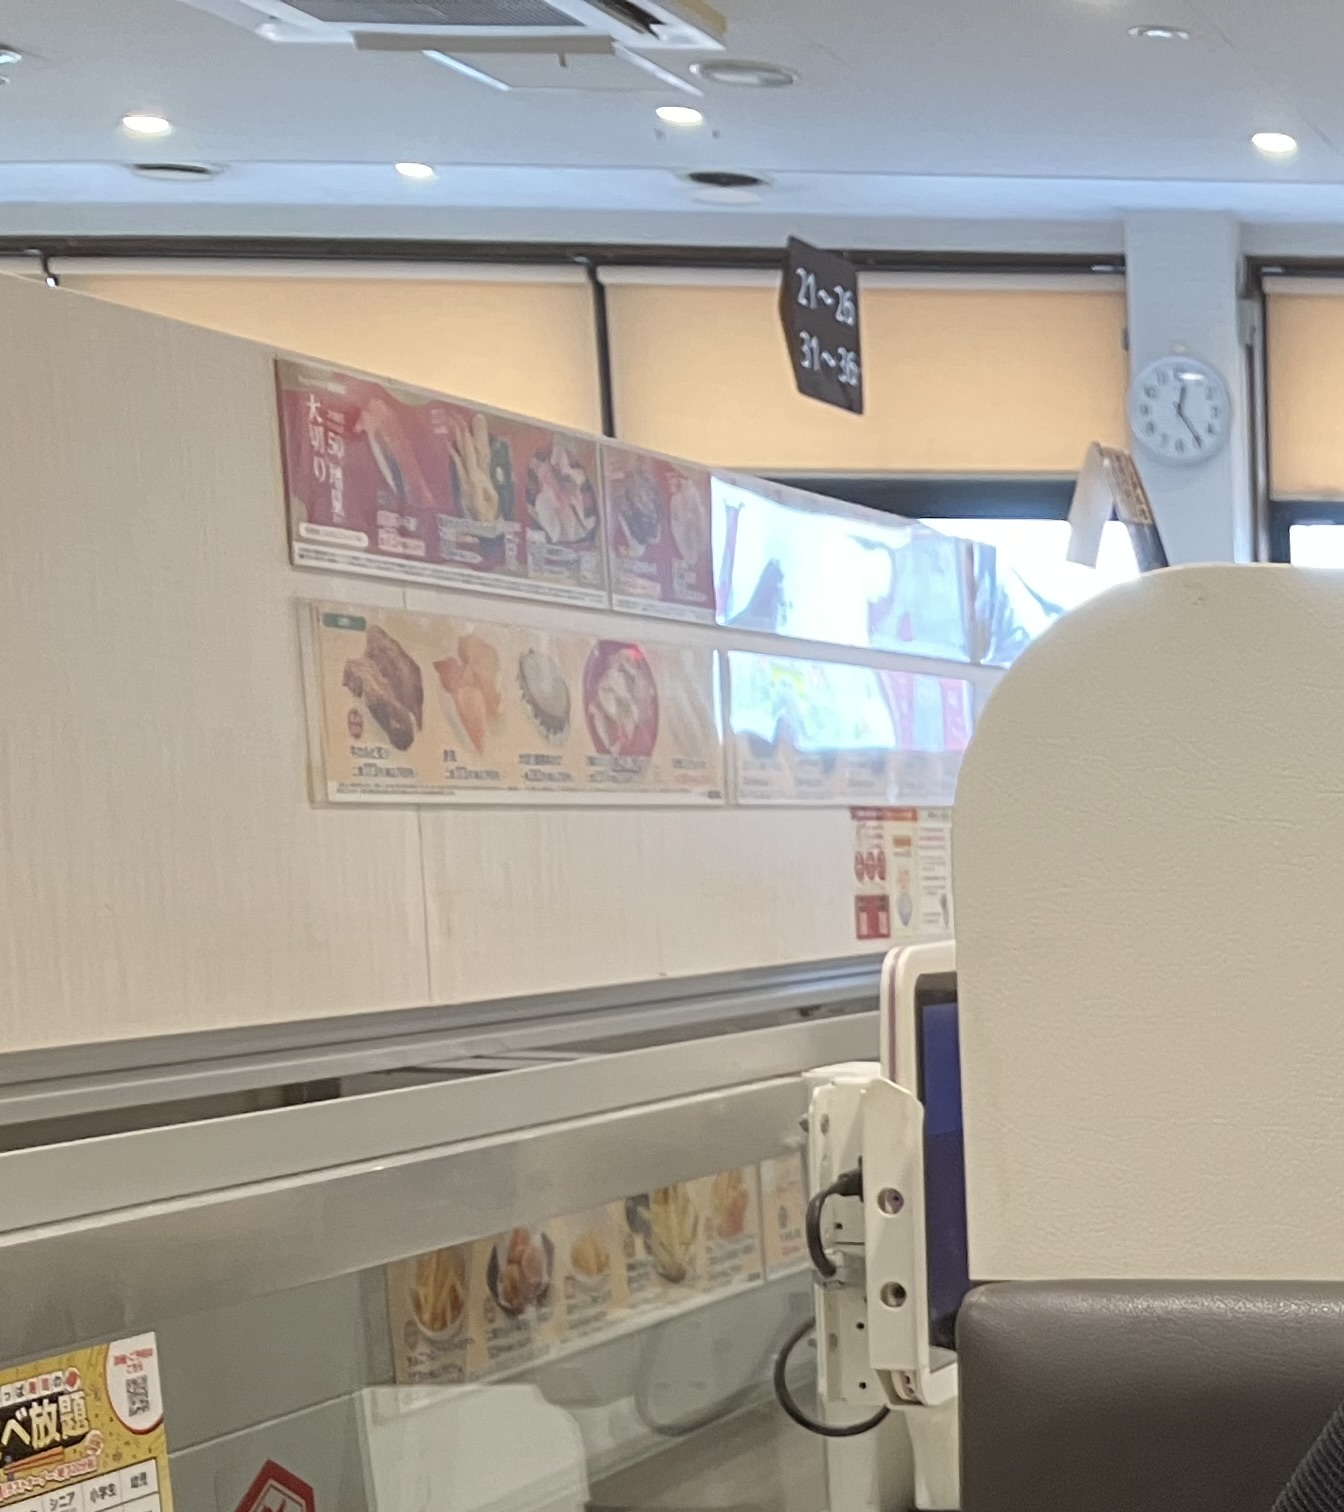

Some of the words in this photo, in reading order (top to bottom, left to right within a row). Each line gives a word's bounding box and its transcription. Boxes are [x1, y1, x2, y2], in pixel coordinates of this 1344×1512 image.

[1, 1391, 90, 1450] べ放題
[50, 1491, 75, 1511] シニア
